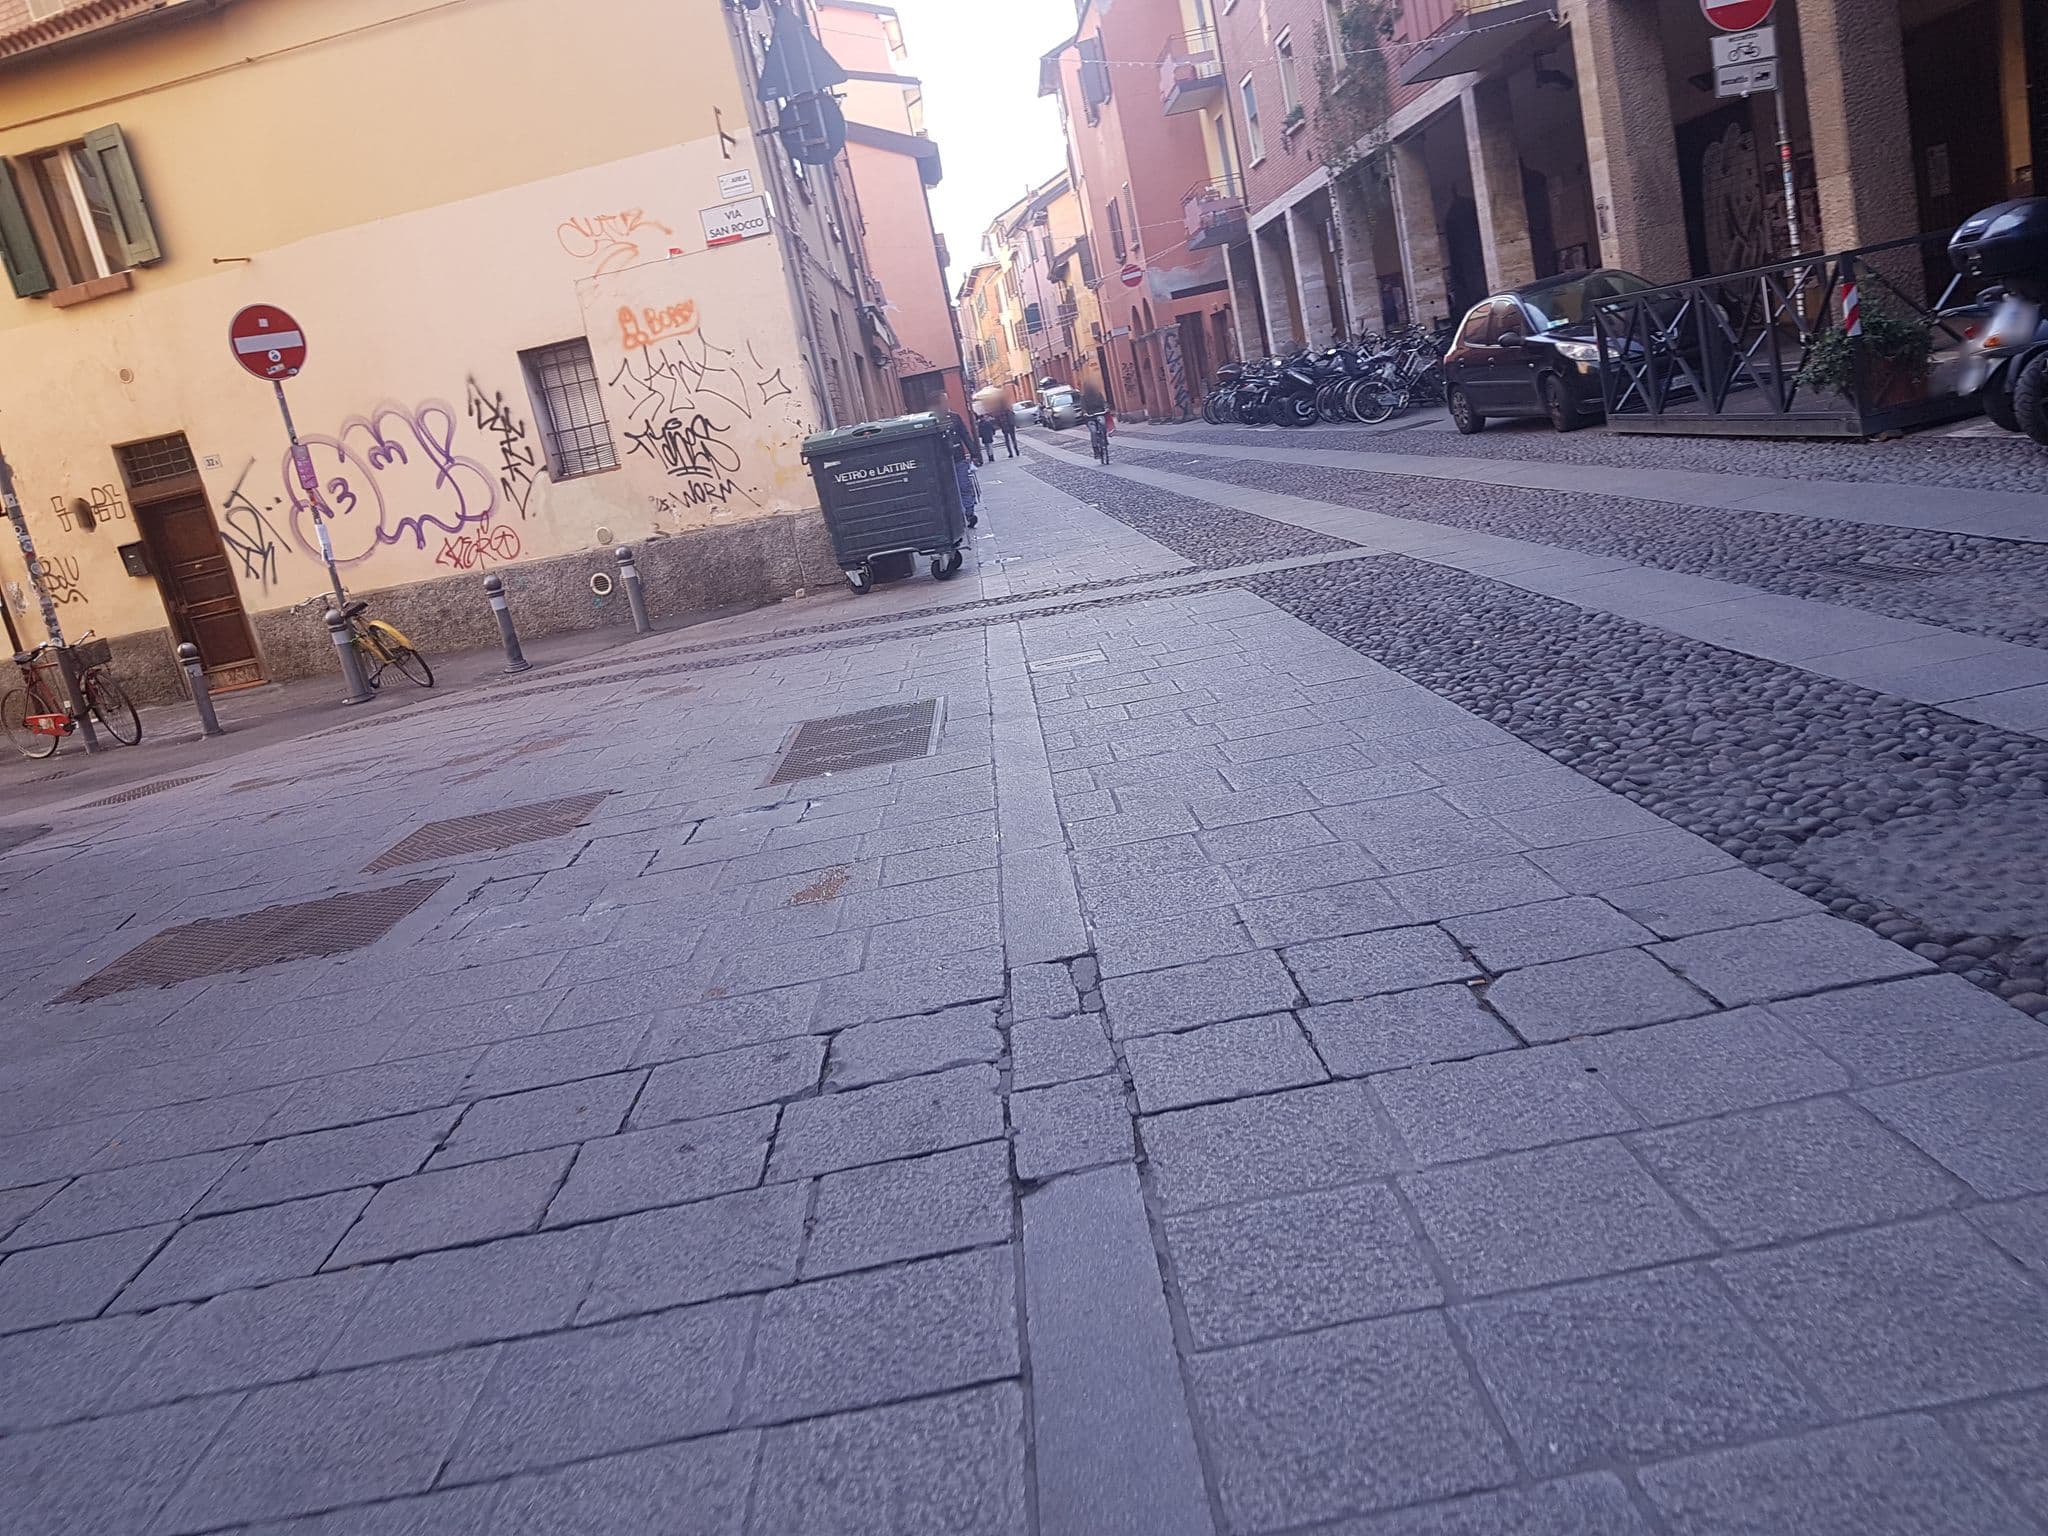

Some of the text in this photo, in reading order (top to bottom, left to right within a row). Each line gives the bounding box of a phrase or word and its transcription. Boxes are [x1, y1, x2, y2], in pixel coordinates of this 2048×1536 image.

[724, 209, 742, 220] VIA
[709, 218, 763, 238] SAN ROCCO
[834, 469, 867, 483] VETRO
[868, 468, 876, 477] e
[876, 459, 918, 475] LATTINE
